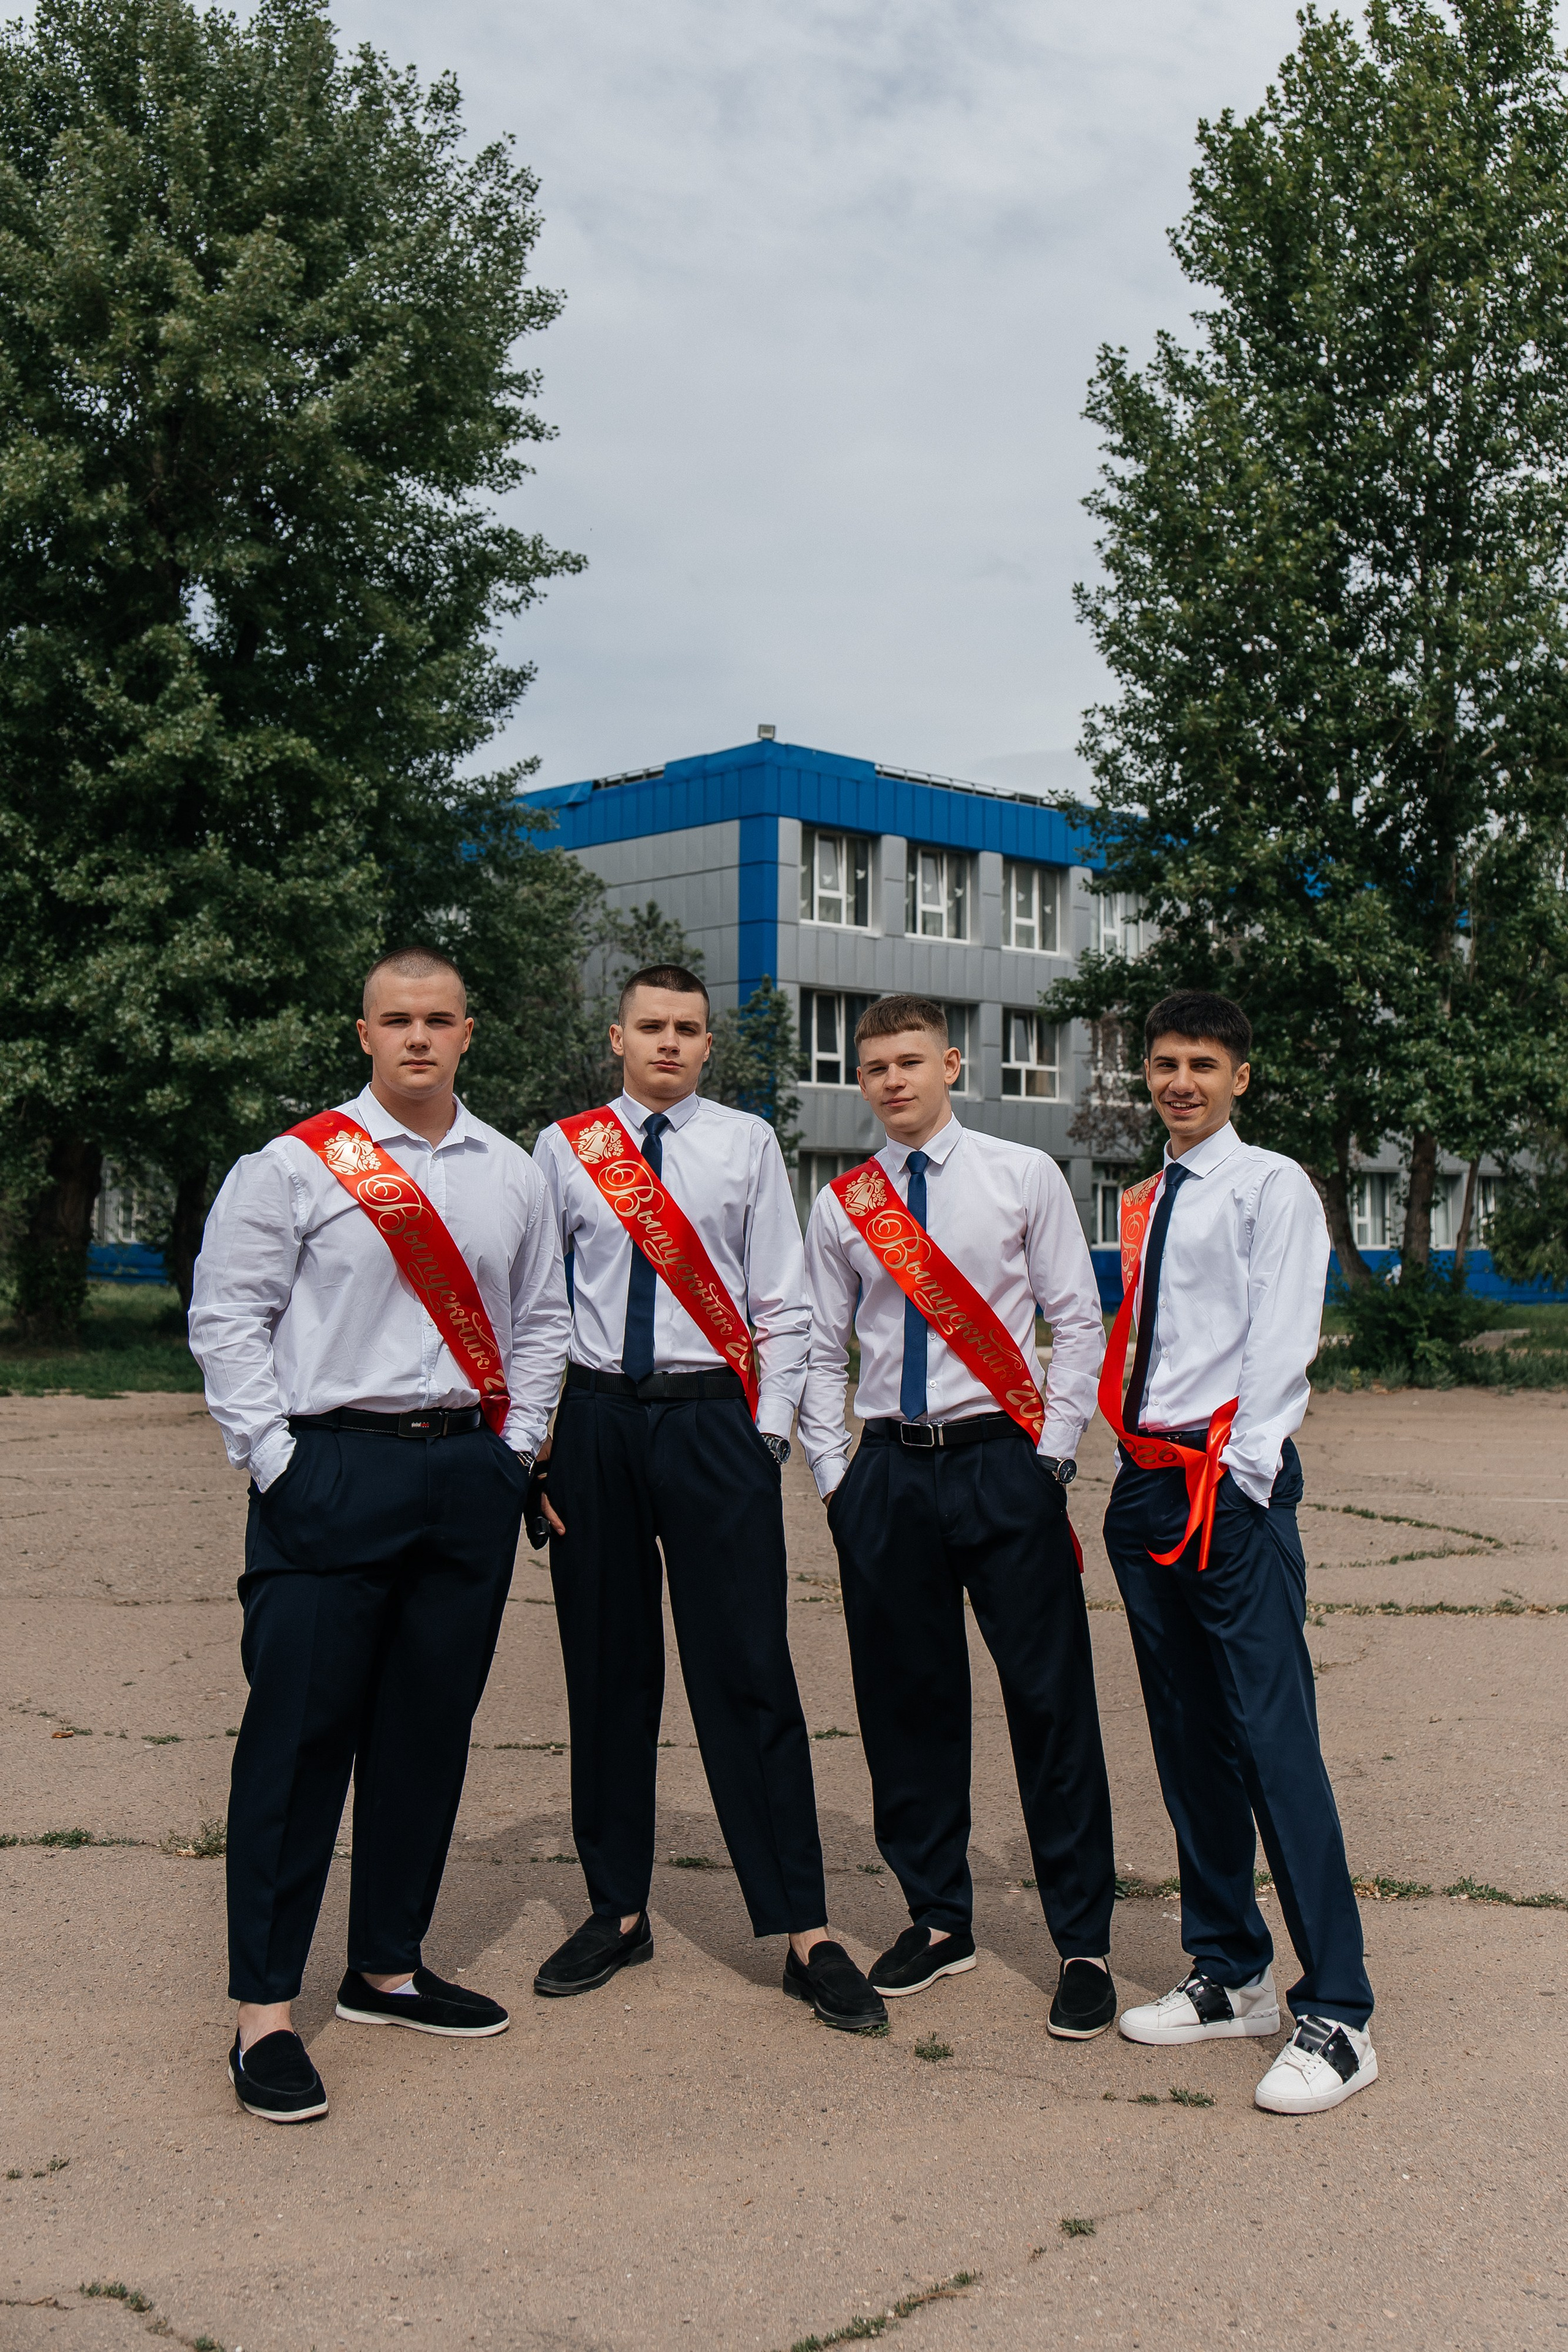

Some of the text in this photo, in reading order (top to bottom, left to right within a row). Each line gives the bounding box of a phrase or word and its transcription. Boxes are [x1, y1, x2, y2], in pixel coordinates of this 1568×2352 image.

[357, 1174, 498, 1370] Выпускник
[598, 1160, 737, 1336] Выпускник
[866, 1210, 1024, 1382] Выпускник
